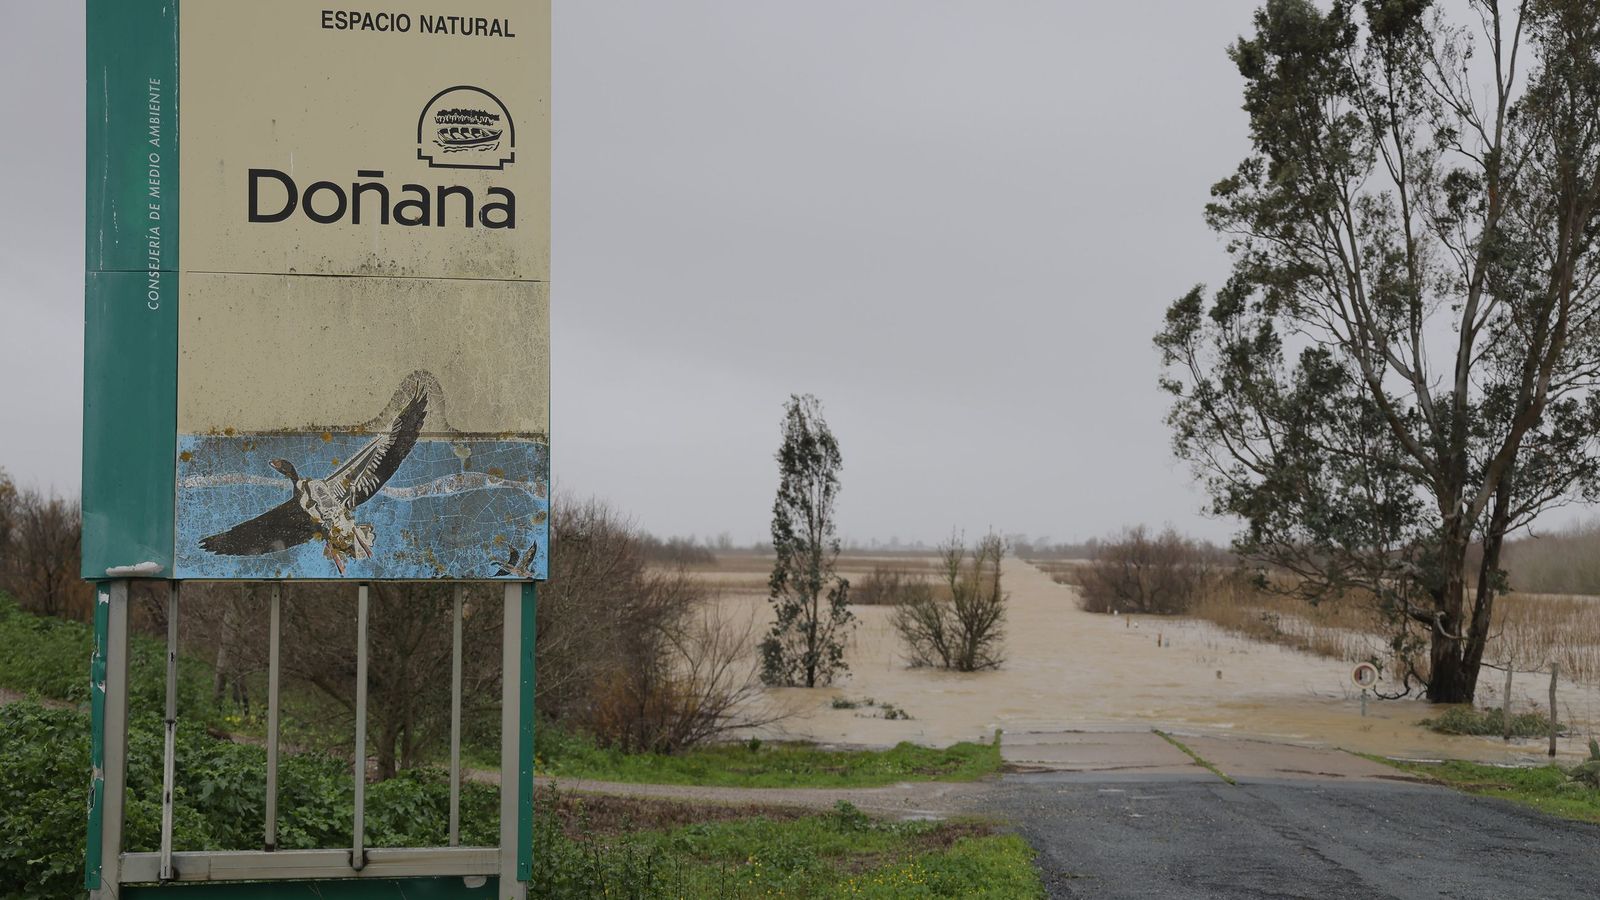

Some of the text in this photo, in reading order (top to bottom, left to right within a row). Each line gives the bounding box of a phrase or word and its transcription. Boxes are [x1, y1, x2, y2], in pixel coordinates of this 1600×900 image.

[321, 10, 516, 38] ESPACIO NATURAL
[146, 77, 162, 311] CONSEJERÍA DE MEDIO AMBIENTE
[248, 169, 516, 229] Doñana
